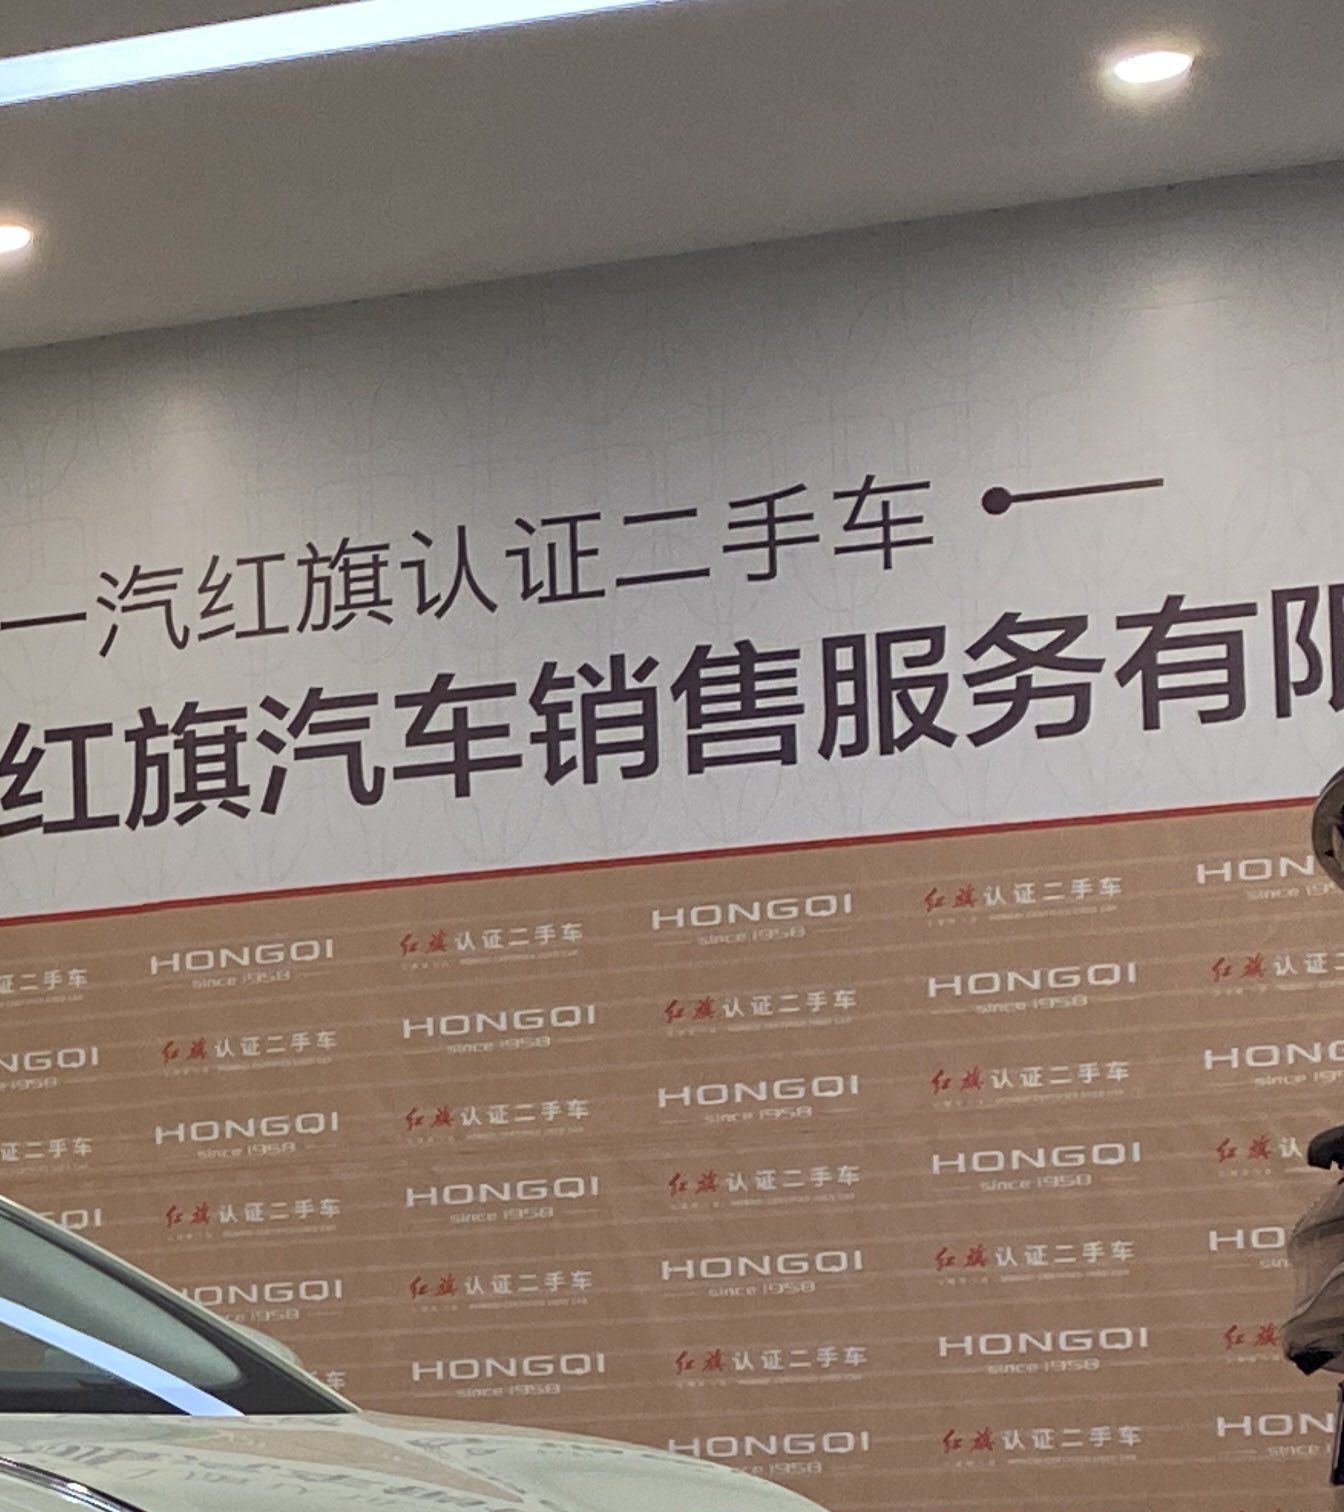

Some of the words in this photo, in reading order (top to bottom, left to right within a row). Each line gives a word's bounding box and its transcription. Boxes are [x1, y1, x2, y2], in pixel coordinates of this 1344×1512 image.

[1, 471, 935, 660] 一汽红旗认证二手车
[652, 894, 852, 929] HONGQI
[150, 938, 333, 975] HONGQI
[928, 963, 1136, 997] HONGQI
[403, 1004, 594, 1038] HONGQI
[658, 1075, 858, 1108] HONGQI
[156, 1112, 338, 1145] HONGQI
[933, 1142, 1140, 1172] HONGQI
[406, 1177, 598, 1207] HONGQI
[663, 1251, 863, 1279] HONGQI
[939, 1328, 1148, 1356] HONGQI
[413, 1354, 604, 1382] HONGQI
